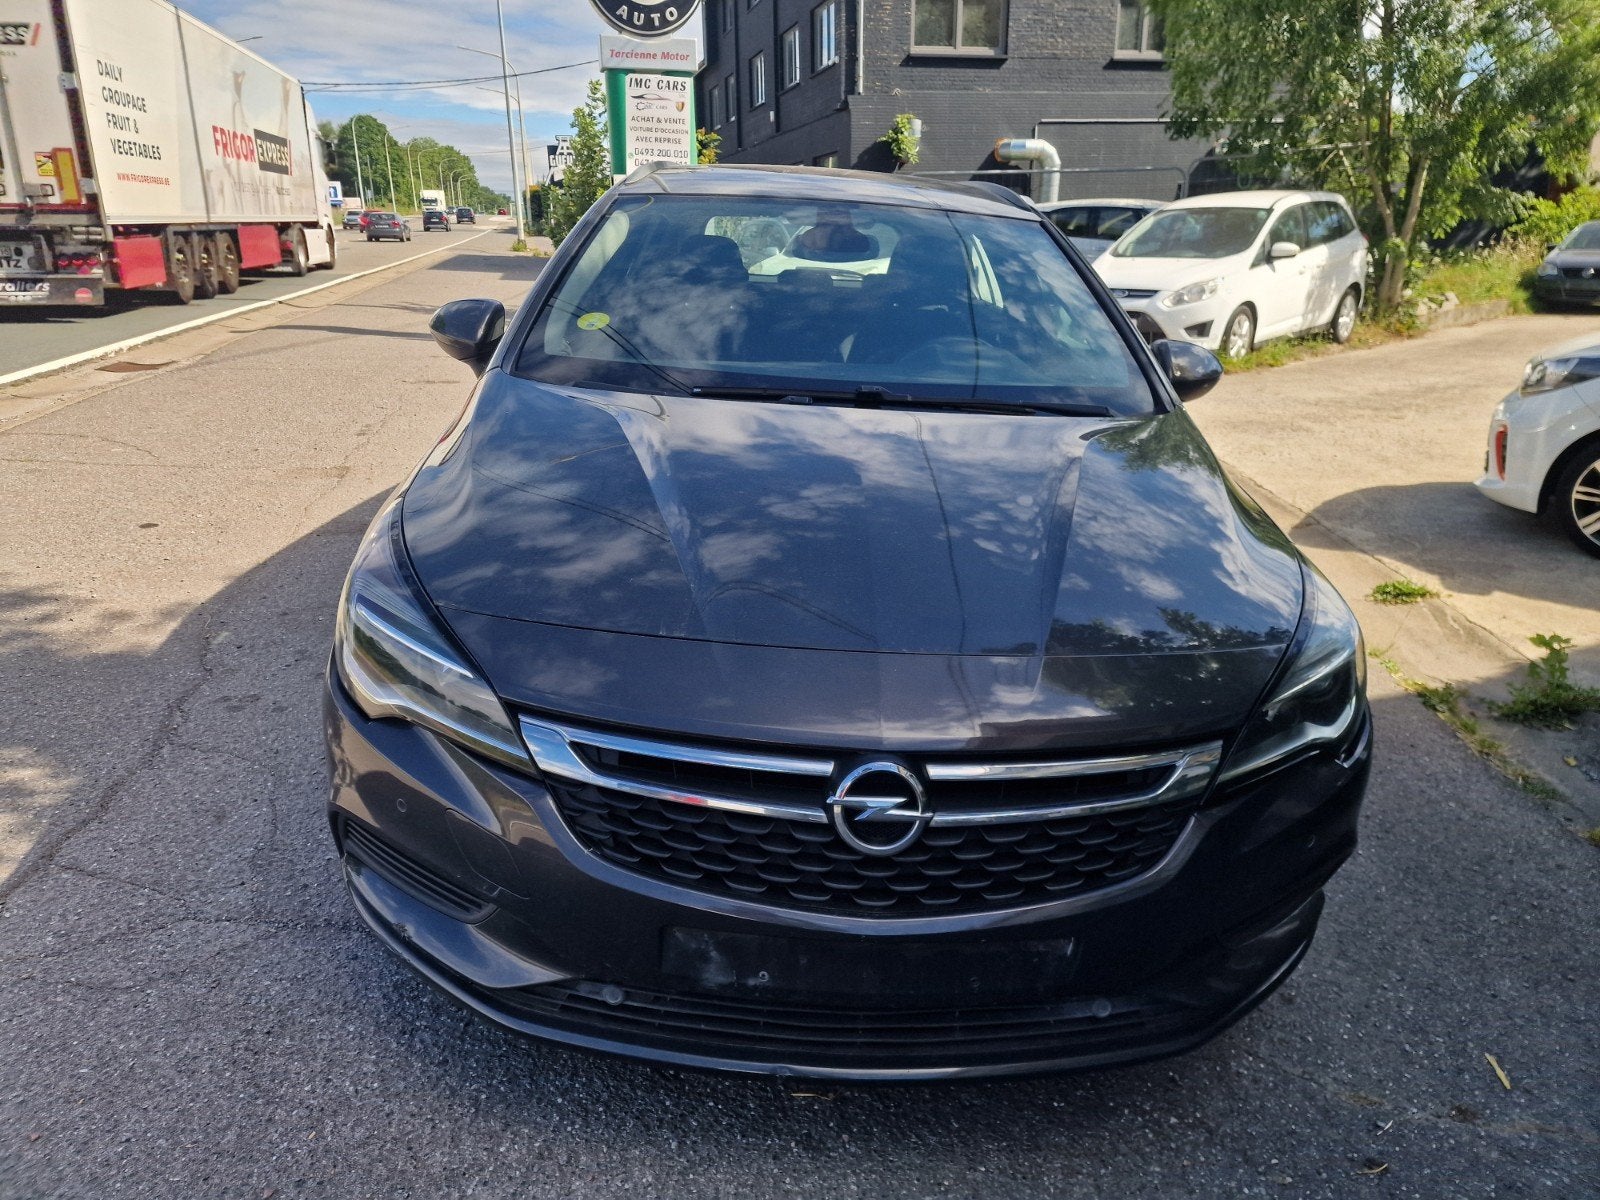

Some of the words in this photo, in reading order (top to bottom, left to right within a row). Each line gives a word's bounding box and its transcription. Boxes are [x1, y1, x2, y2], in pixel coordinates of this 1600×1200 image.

[616, 5, 678, 26] AUTO
[661, 51, 690, 61] Motor
[96, 59, 123, 82] DAILY
[629, 77, 651, 89] IMC
[657, 79, 687, 92] CARS
[101, 86, 147, 113] GROUPAGE
[106, 112, 132, 132] FRUIT
[133, 118, 139, 134] &
[663, 117, 686, 125] VENTE
[110, 138, 162, 161] VEGETABLES
[211, 125, 256, 163] FRIGOR
[256, 139, 289, 167] EXPRESS
[654, 137, 682, 145] REPRISE
